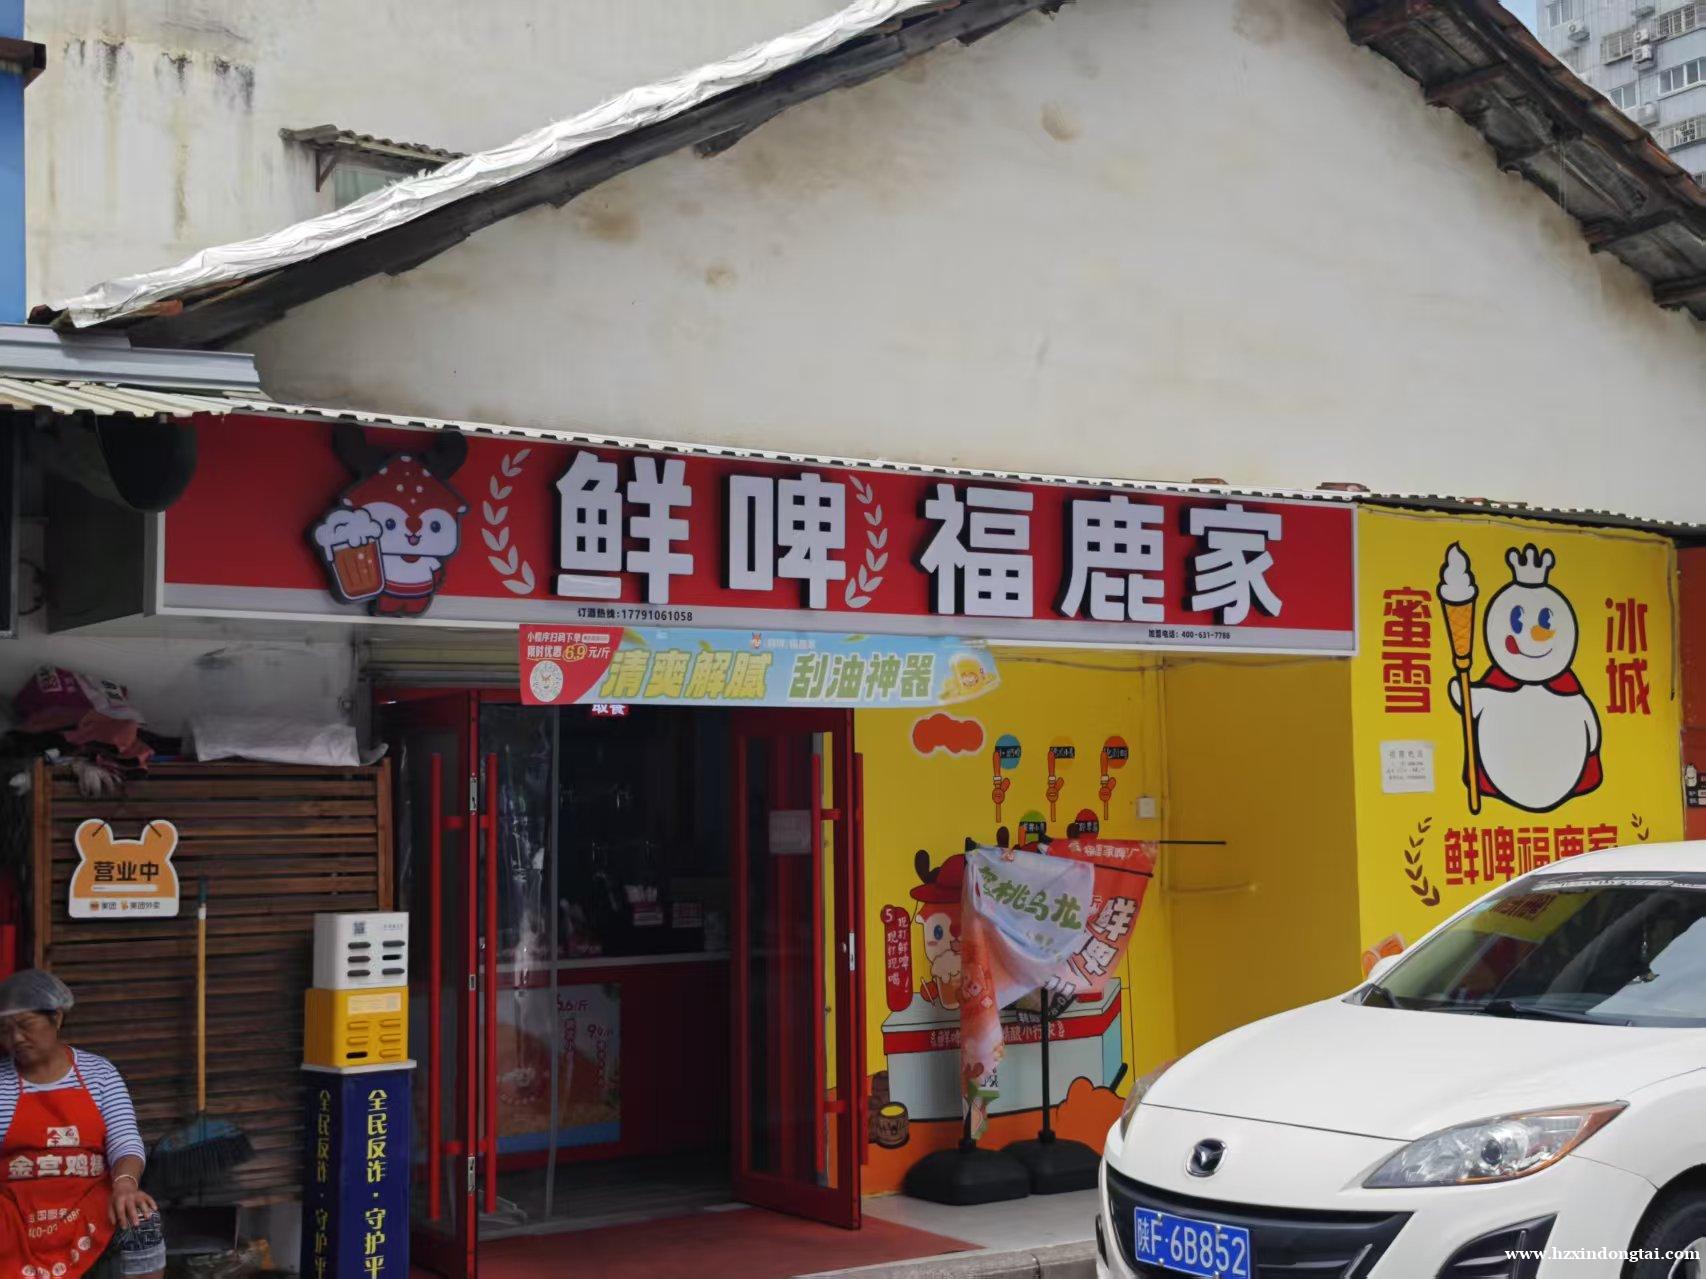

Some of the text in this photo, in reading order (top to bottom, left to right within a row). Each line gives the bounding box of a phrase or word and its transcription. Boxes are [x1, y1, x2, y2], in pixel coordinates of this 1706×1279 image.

[556, 451, 1282, 625] 鲜啤 福鹿家
[789, 651, 935, 700] 刮油神器
[1382, 587, 1432, 714] 蜜雪
[1605, 598, 1651, 716] 冰城
[93, 861, 159, 882] 营业中
[130, 901, 161, 910] 美团外卖
